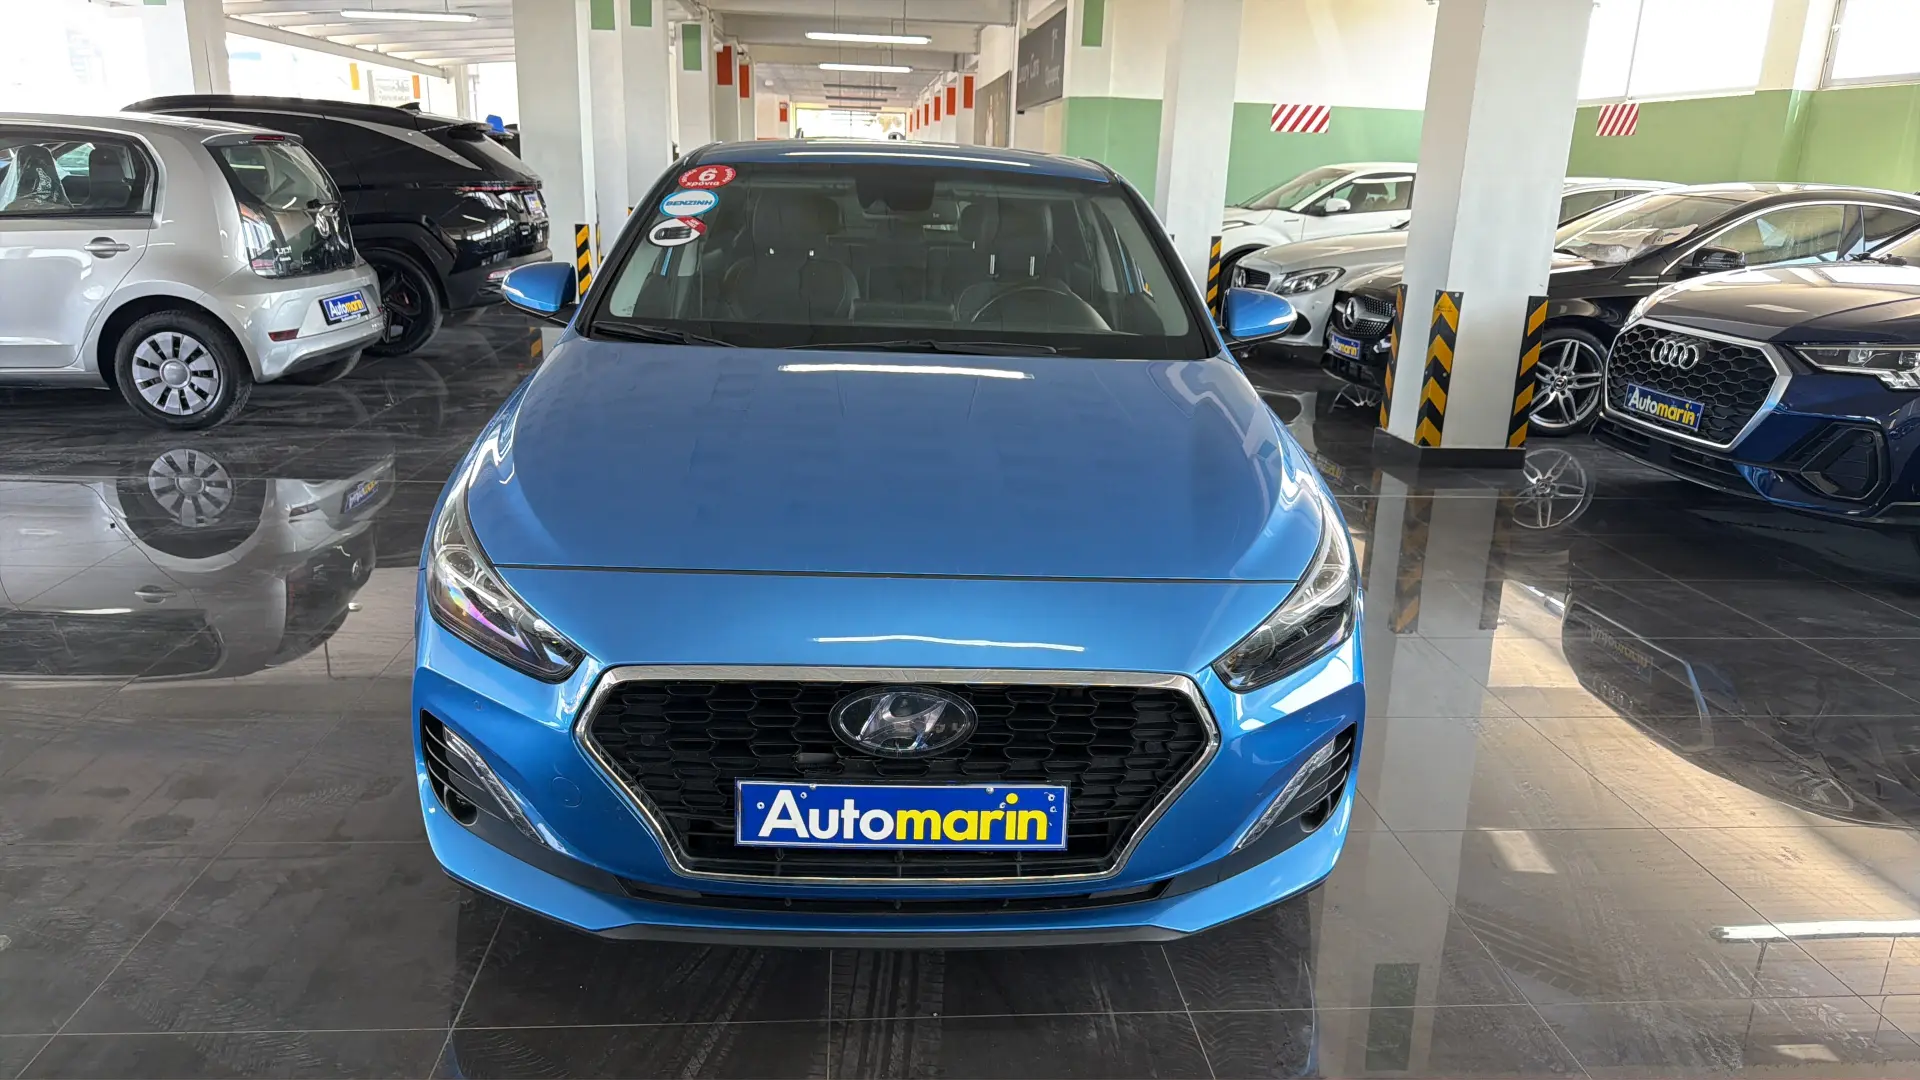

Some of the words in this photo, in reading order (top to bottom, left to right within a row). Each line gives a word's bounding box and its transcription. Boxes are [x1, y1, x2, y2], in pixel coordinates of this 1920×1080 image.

[699, 169, 717, 181] 6
[1628, 387, 1696, 426] Automarin
[757, 789, 1048, 841] Automarin
